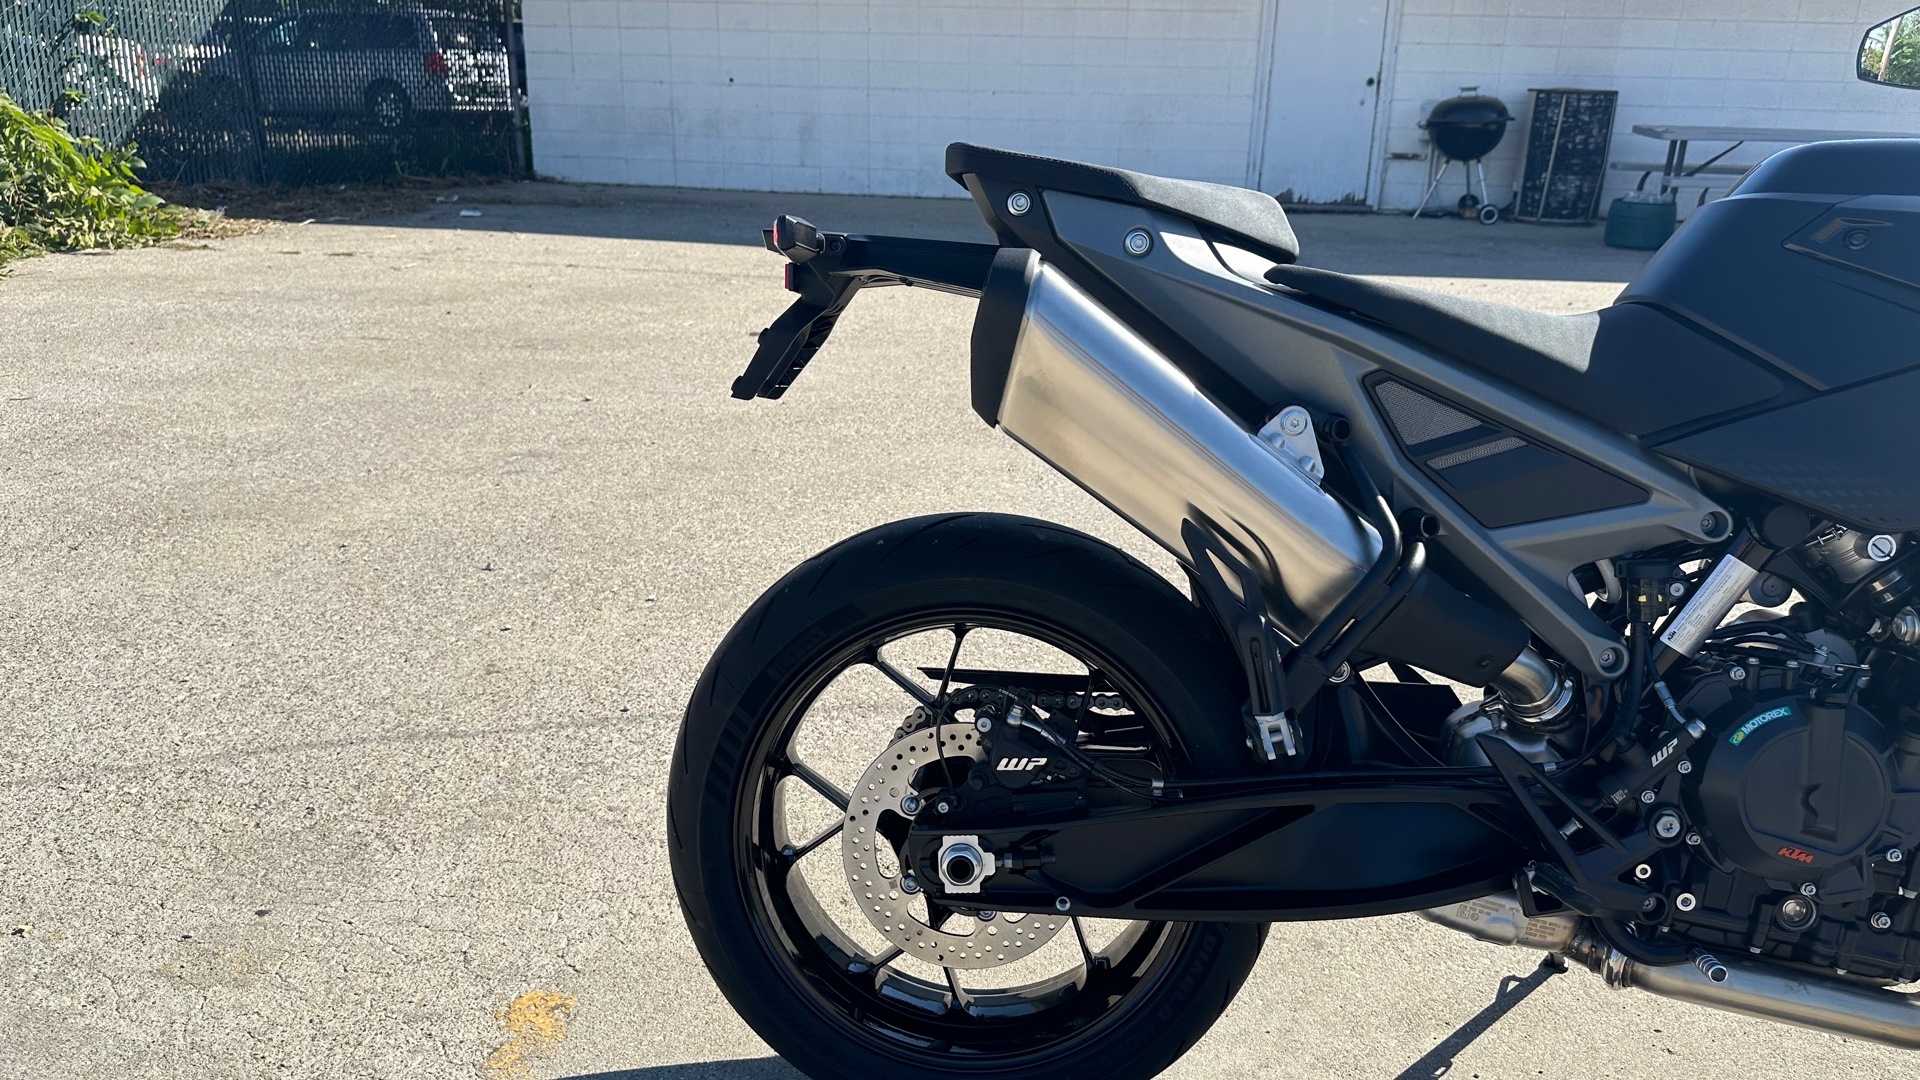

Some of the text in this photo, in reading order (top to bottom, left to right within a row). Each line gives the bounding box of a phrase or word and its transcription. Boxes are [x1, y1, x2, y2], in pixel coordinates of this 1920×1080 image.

[1741, 707, 1788, 734] MOTOREX
[1651, 737, 1678, 768] WP
[997, 757, 1047, 771] WP
[1777, 847, 1814, 864] KTM
